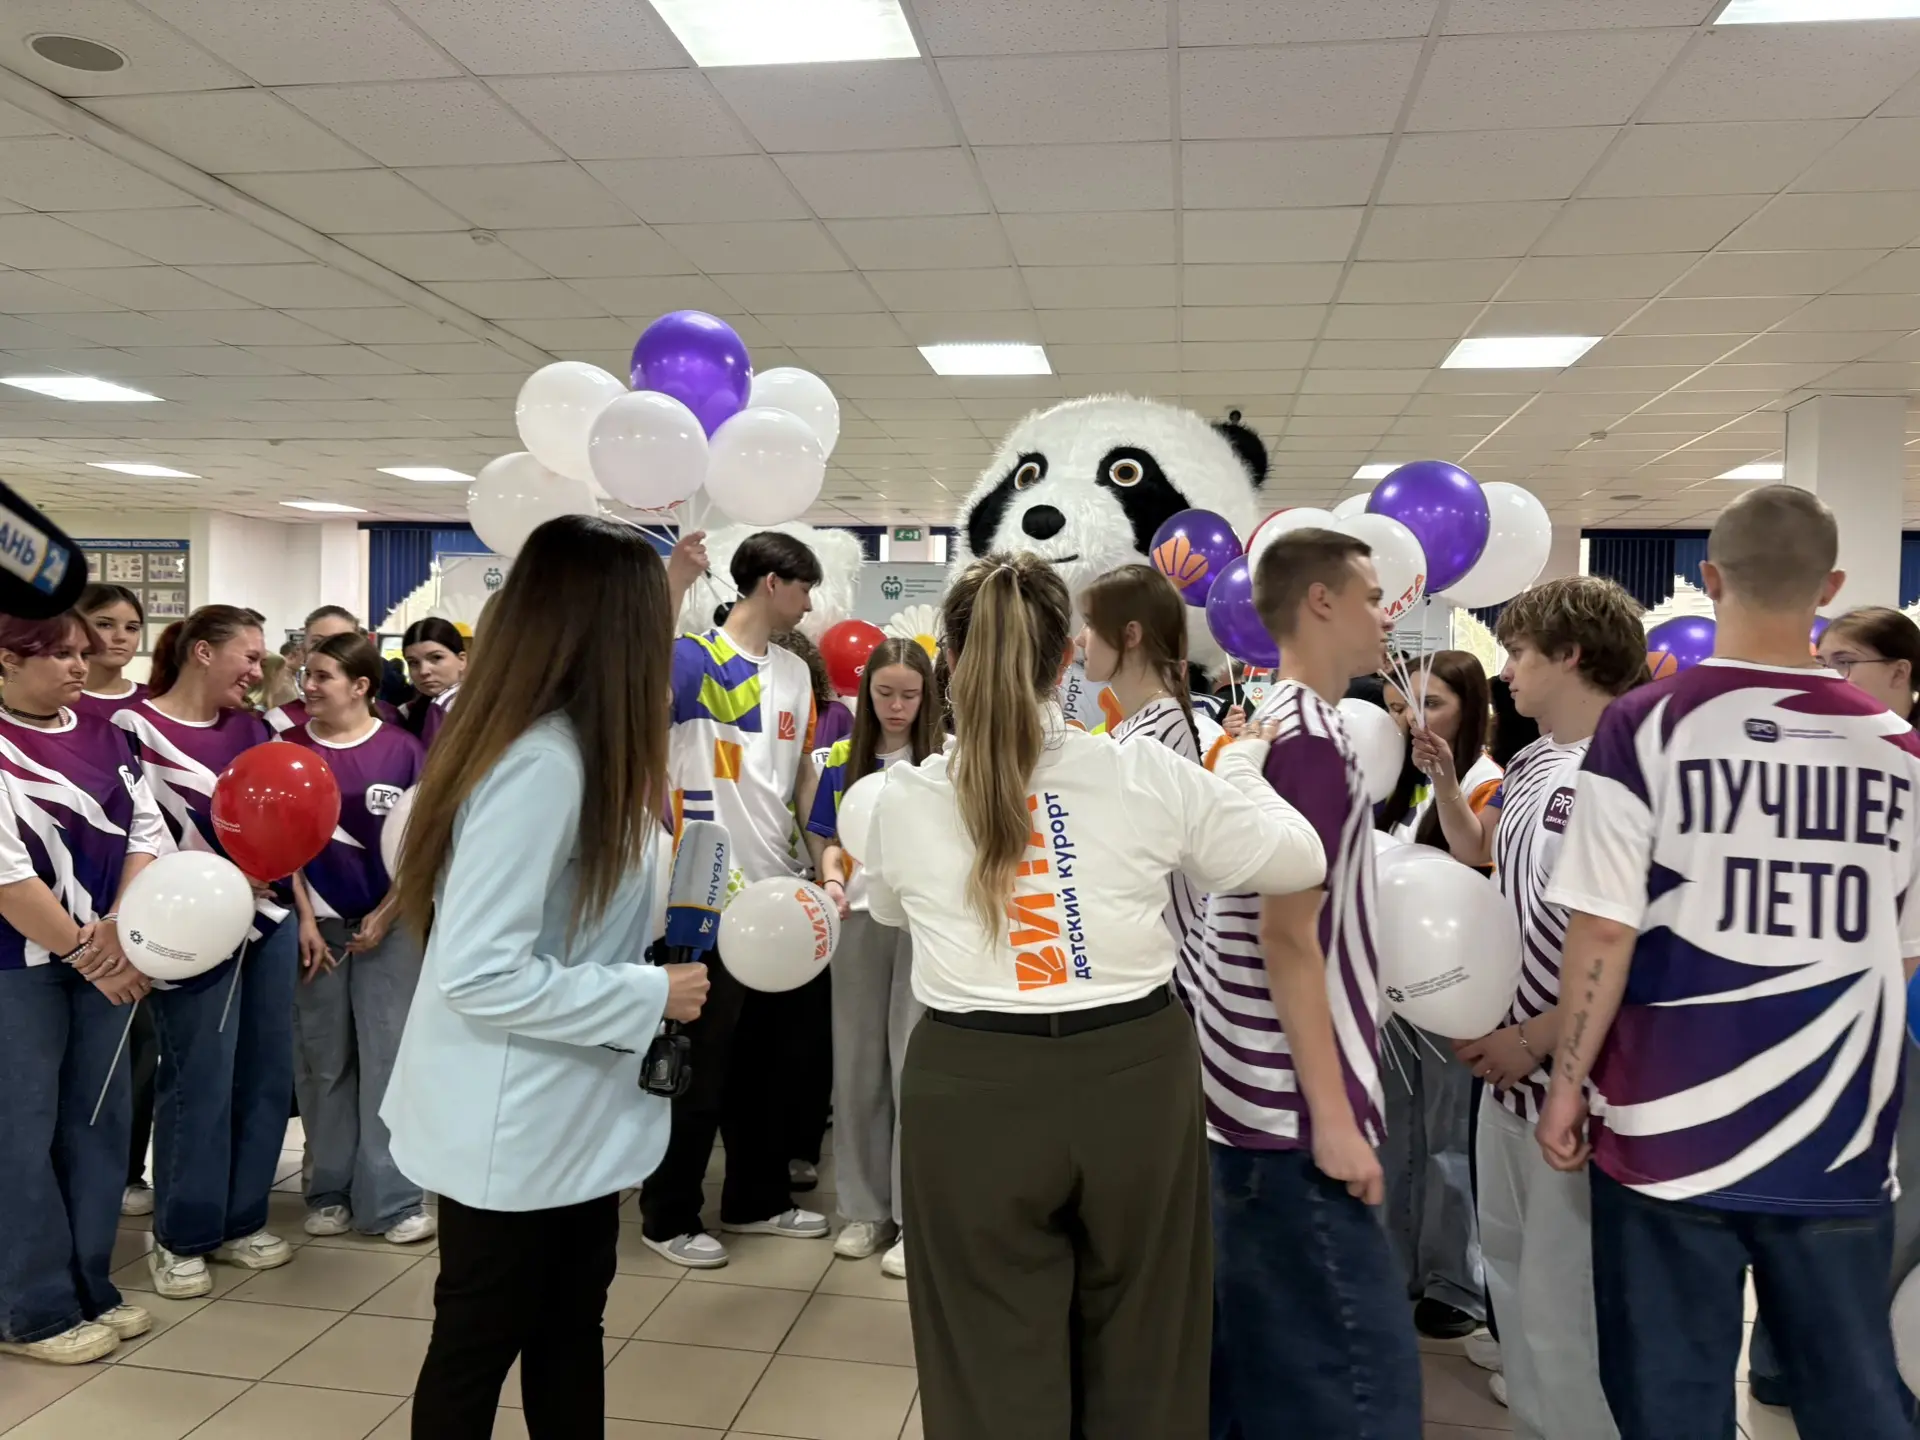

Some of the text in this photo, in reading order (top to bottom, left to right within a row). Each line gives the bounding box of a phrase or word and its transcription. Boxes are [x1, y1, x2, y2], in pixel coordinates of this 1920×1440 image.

[1384, 573, 1424, 616] ИТА
[1063, 675, 1083, 720] урорт
[1550, 792, 1575, 816] PR
[1677, 758, 1911, 853] ЛУЧШЕЕ
[706, 842, 725, 907] КУБАНЬ
[1044, 792, 1092, 980] детский курорт
[1716, 856, 1870, 944] ЛЕТО
[699, 917, 713, 934] 24
